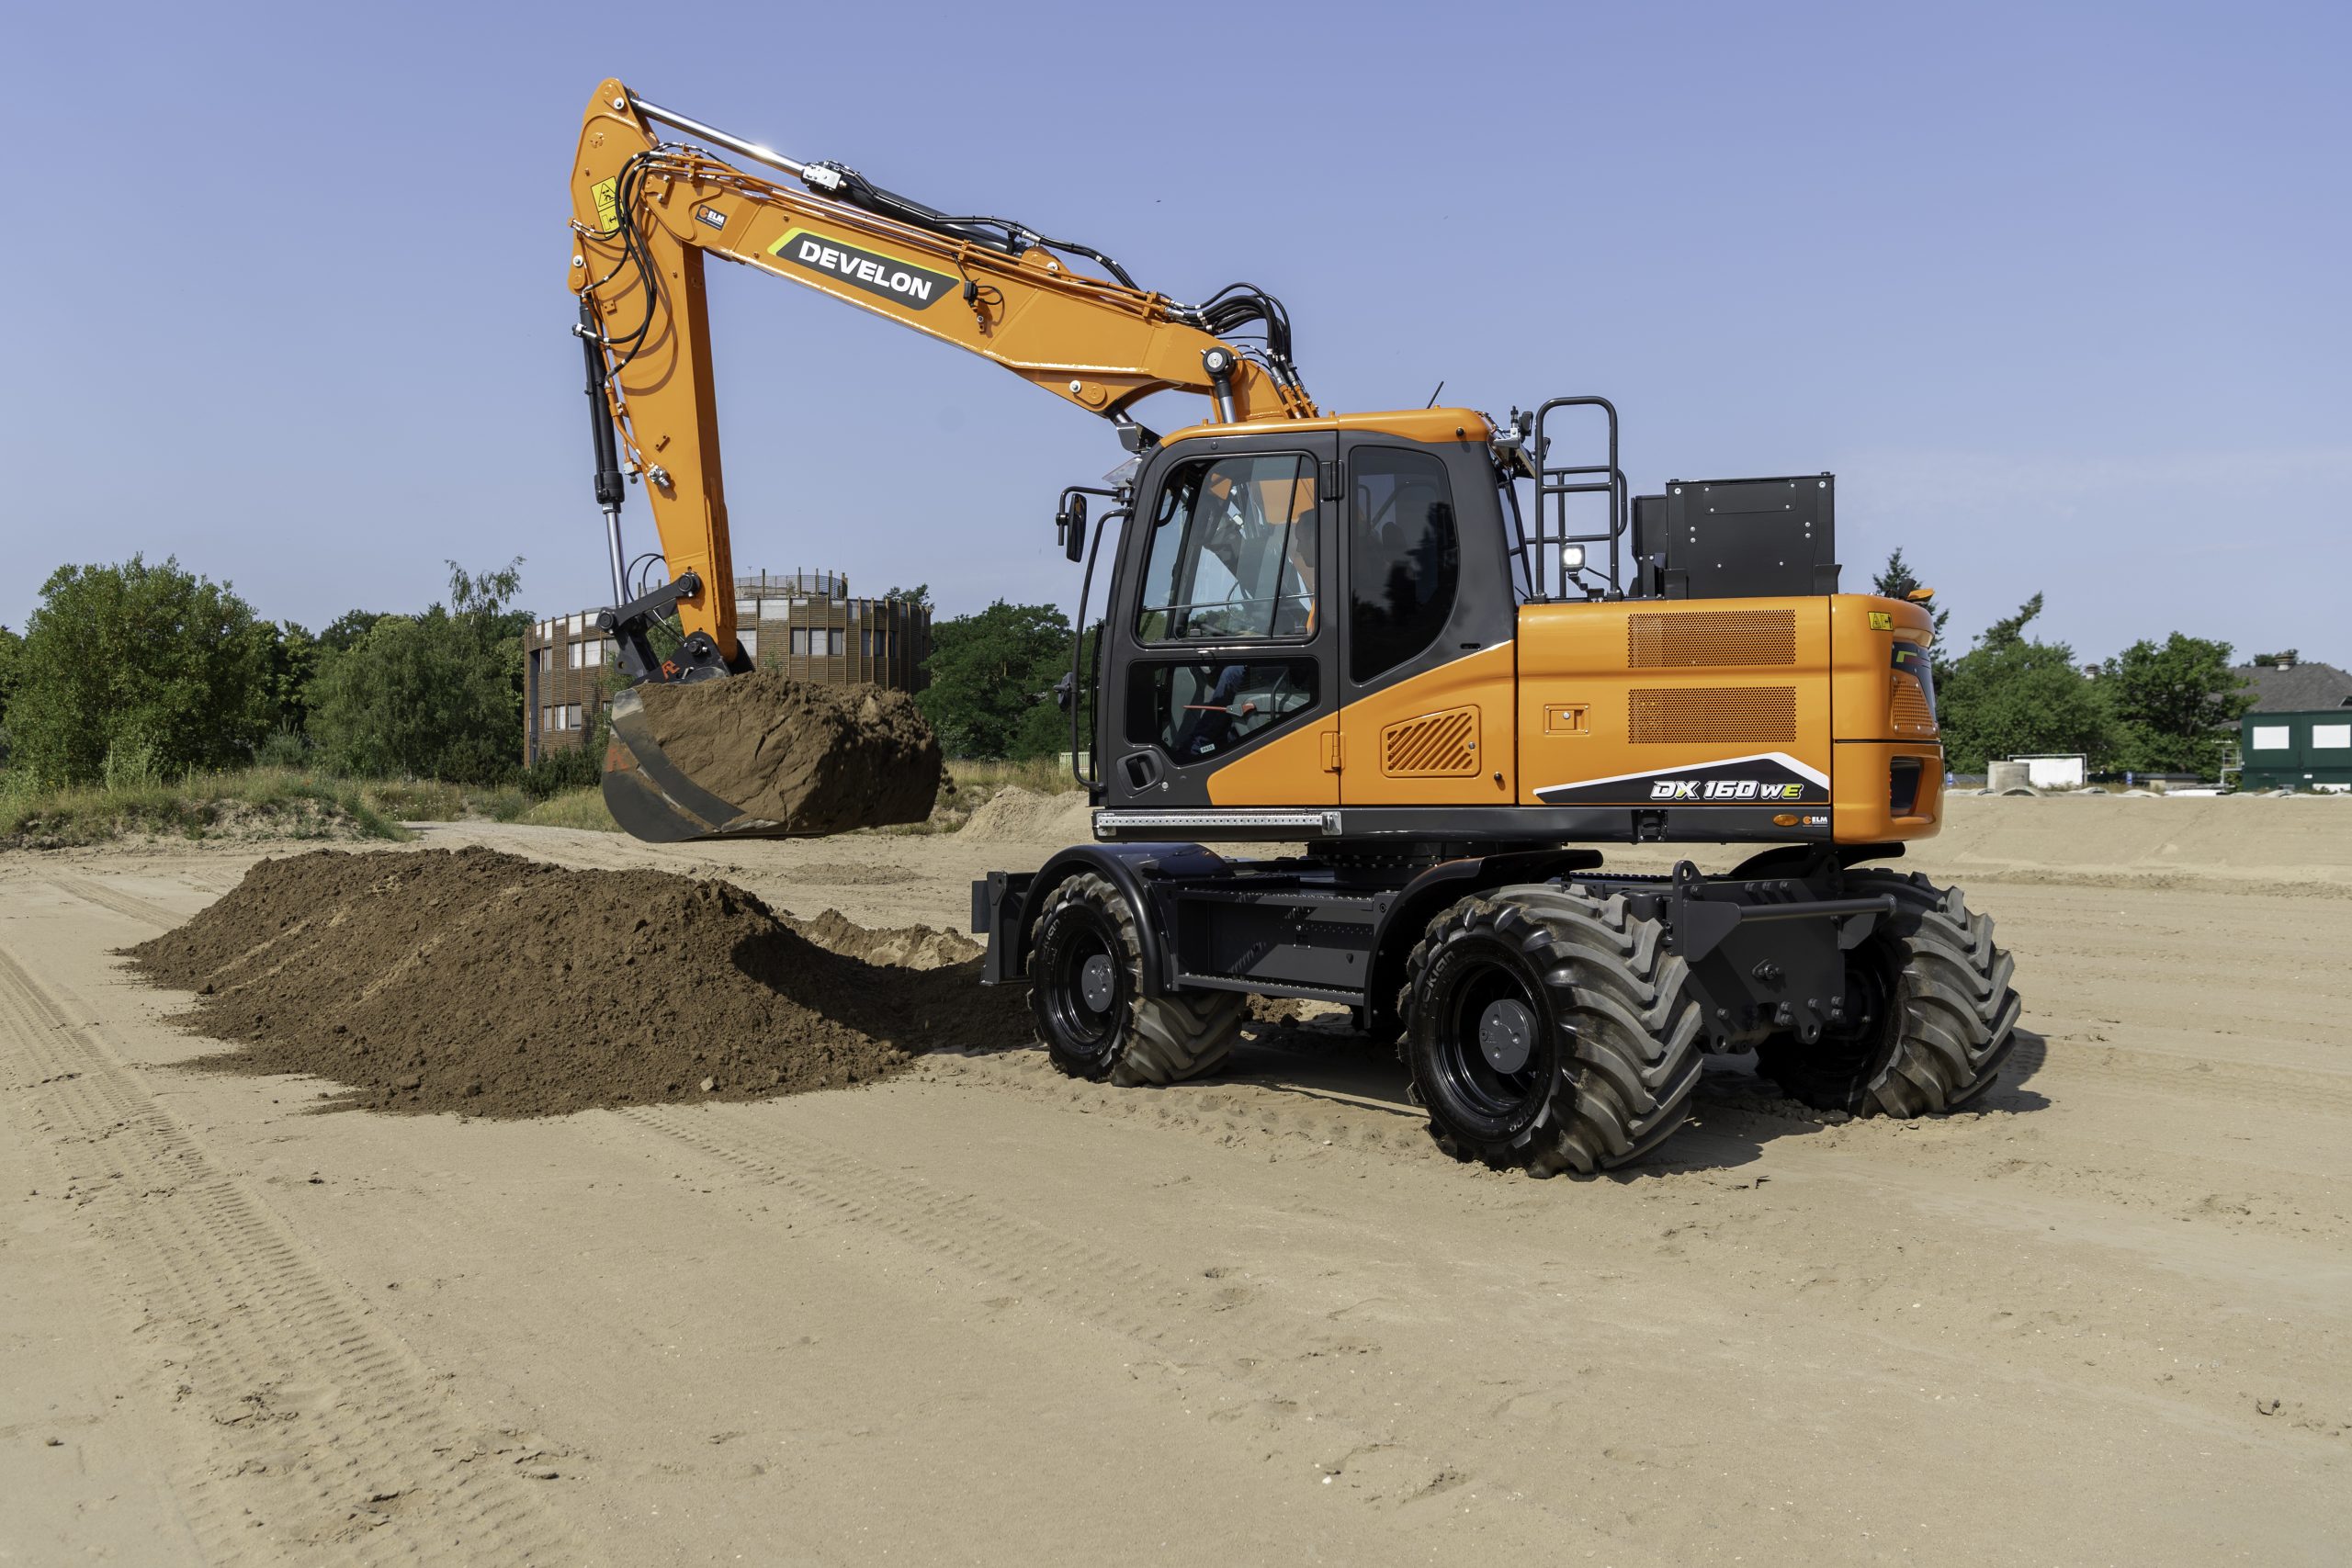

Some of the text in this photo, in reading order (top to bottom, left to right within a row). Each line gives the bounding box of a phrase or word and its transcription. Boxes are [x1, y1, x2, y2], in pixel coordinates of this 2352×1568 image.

[707, 210, 725, 224] ELM
[798, 241, 932, 300] DEVELON
[1650, 781, 1701, 799] DX
[1703, 781, 1759, 799] 160
